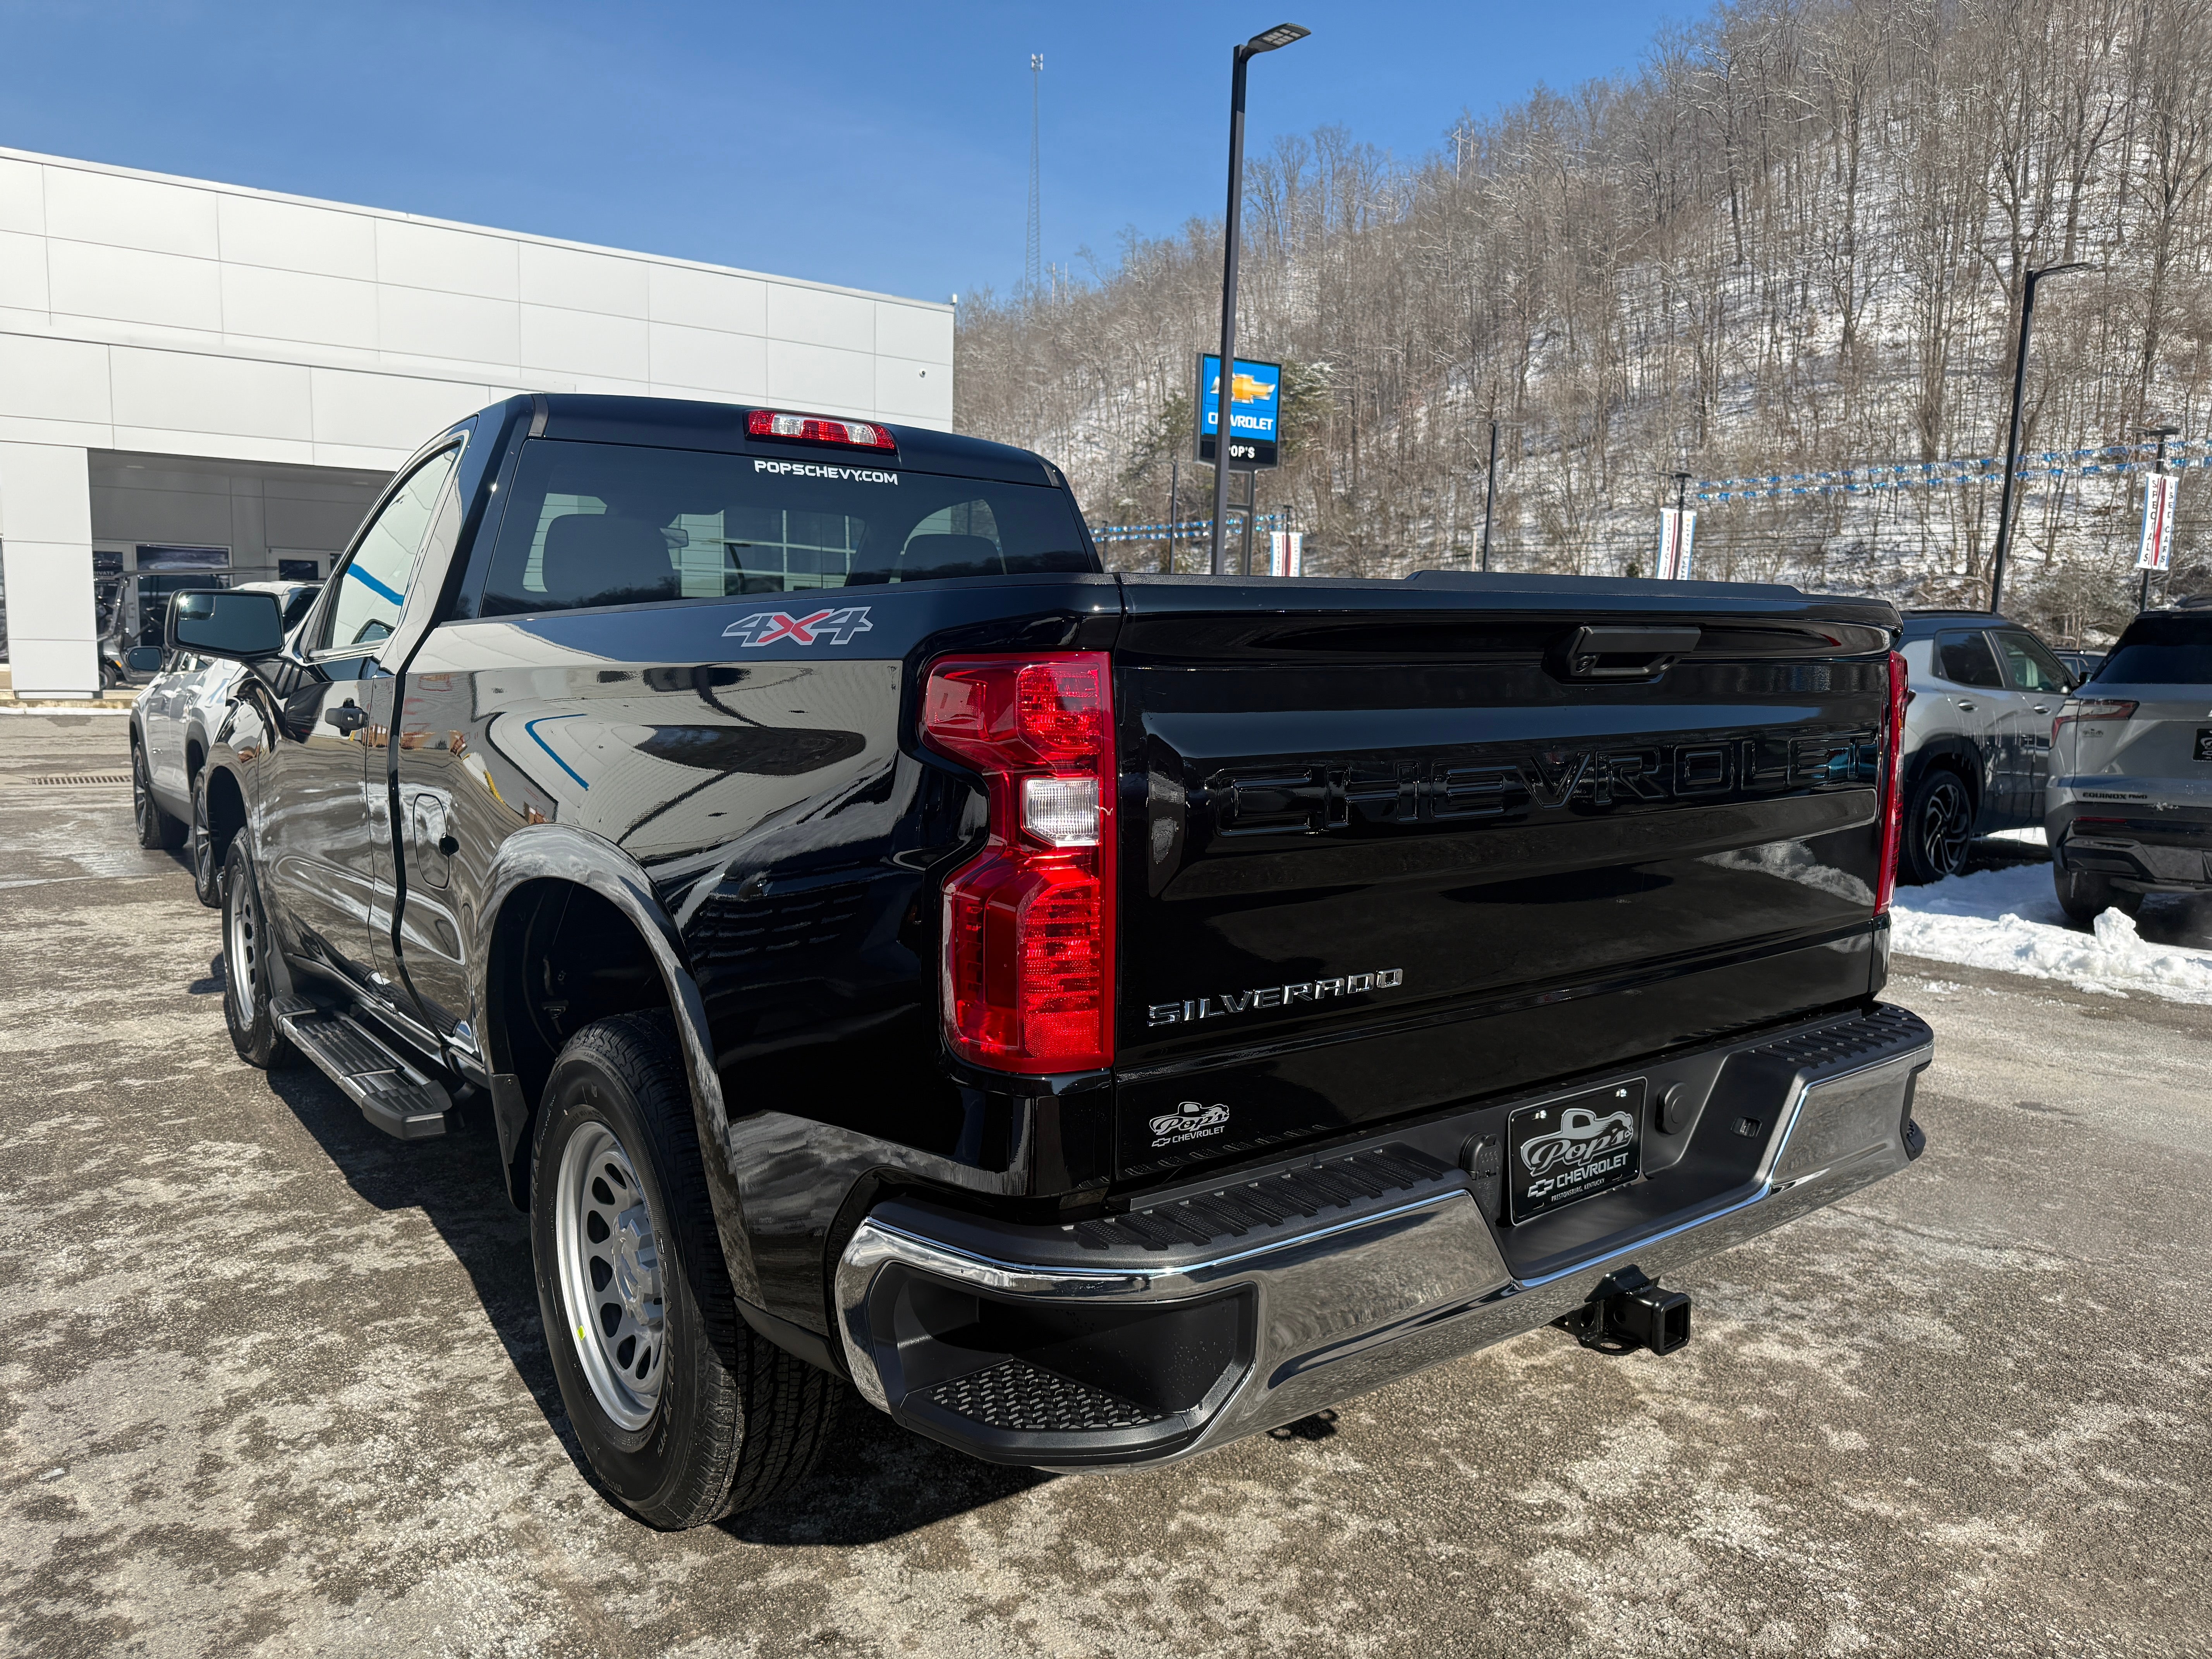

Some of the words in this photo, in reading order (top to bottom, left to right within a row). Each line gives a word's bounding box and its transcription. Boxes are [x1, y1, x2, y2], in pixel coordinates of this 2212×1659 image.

[1208, 412, 1274, 431] CVROLET
[1228, 445, 1255, 459] OP'S
[754, 460, 898, 486] POPSCHEVY.COM
[2161, 526, 2170, 563] CARS
[1215, 730, 1874, 838] CHEVROLET
[1147, 967, 1403, 1027] SILVERADO
[1172, 1126, 1225, 1143] CHEVROLET
[1556, 1152, 1628, 1188] CHEVROLET
[1584, 1177, 1605, 1190] KENTUCKY
